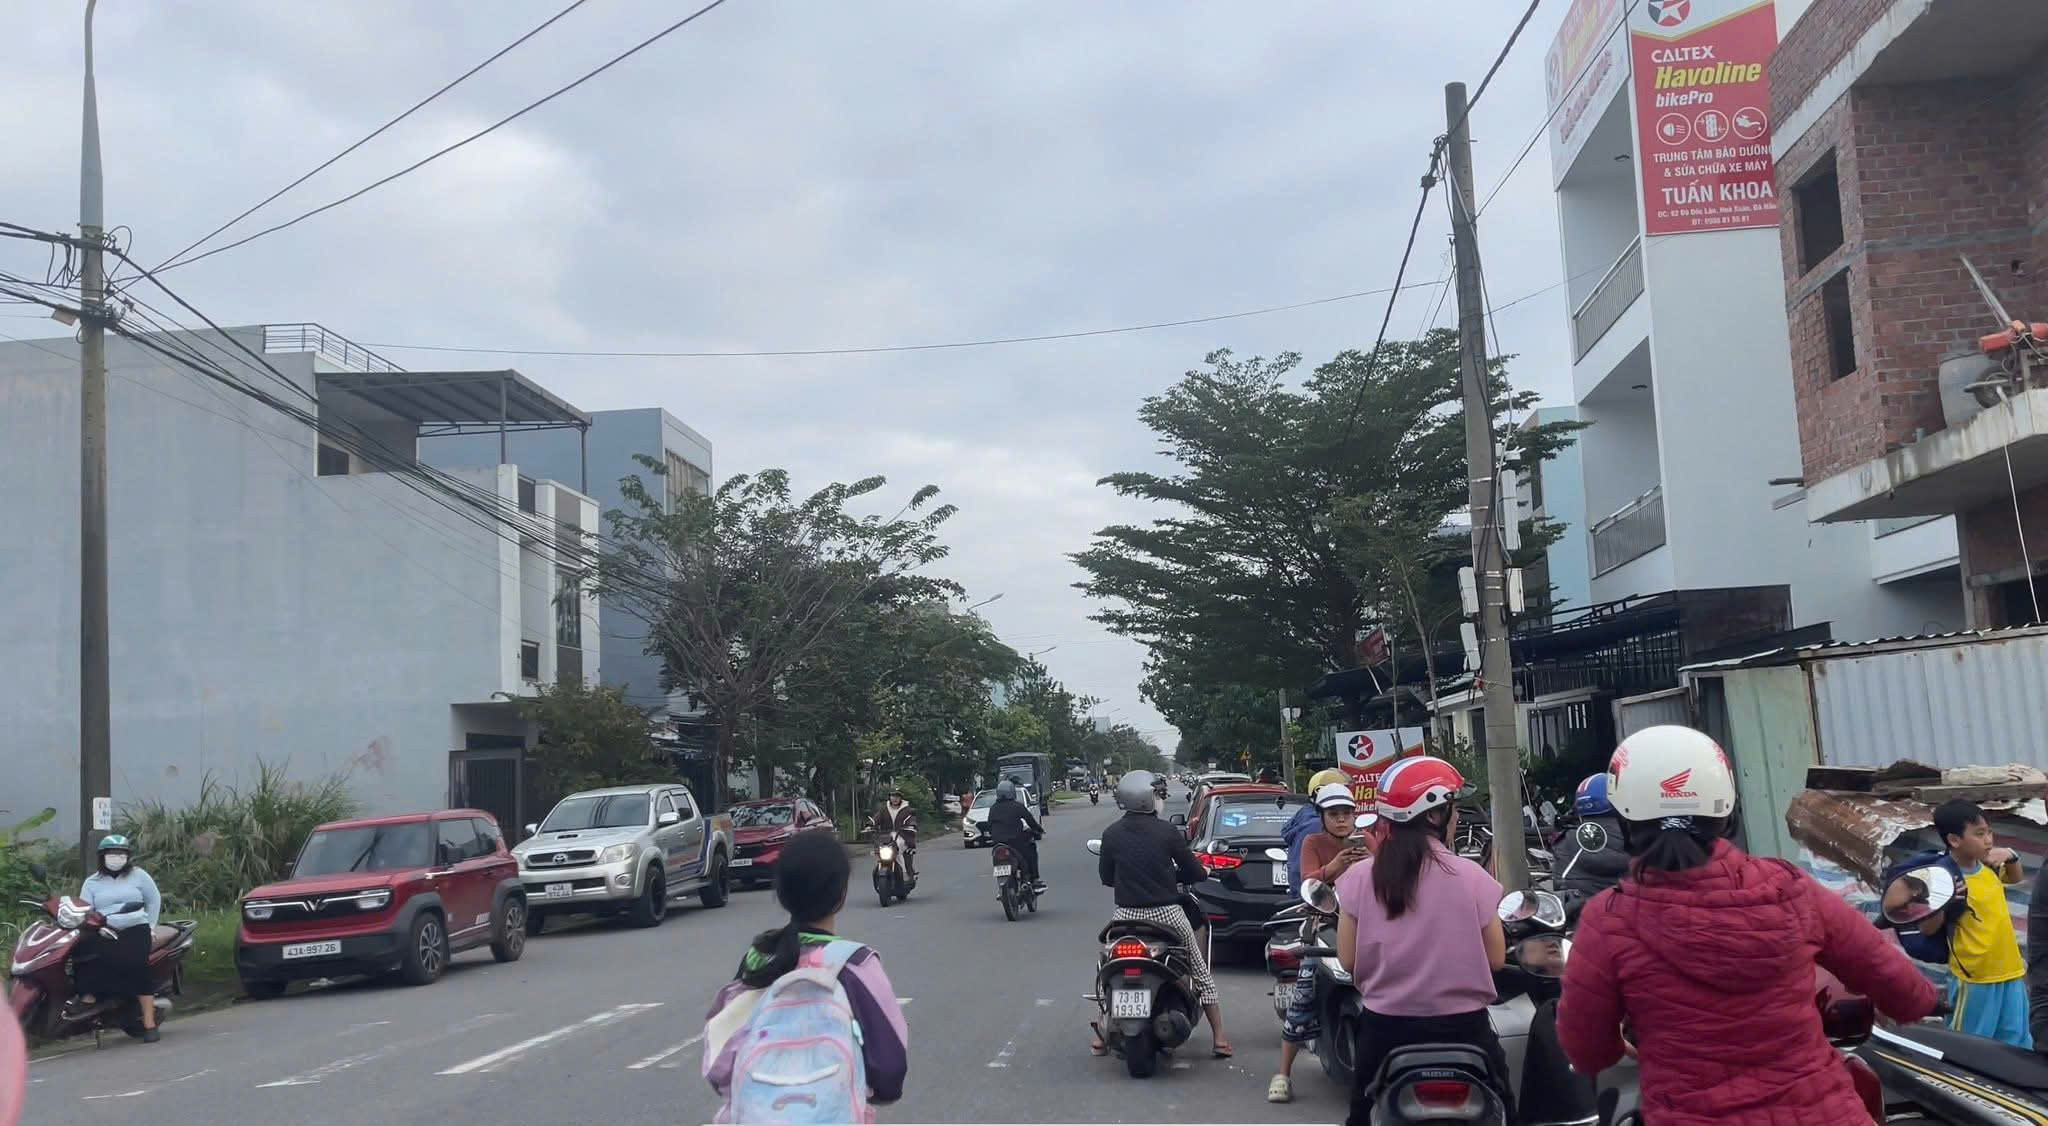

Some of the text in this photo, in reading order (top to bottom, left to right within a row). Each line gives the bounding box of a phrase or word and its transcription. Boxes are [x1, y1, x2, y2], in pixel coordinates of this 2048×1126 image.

[1651, 46, 1715, 63] CALTEX
[1655, 61, 1762, 89] Havoline
[1655, 90, 1713, 107] bikePro
[1653, 151, 1688, 163] TRUNG
[1691, 148, 1713, 160] TÂM
[1715, 145, 1736, 158] BẢO
[1664, 159, 1767, 177] & SỬA CHỮA XE MÁY
[1661, 180, 1774, 205] TUẤN KHOA
[1115, 1004, 1149, 1017] 193.54
